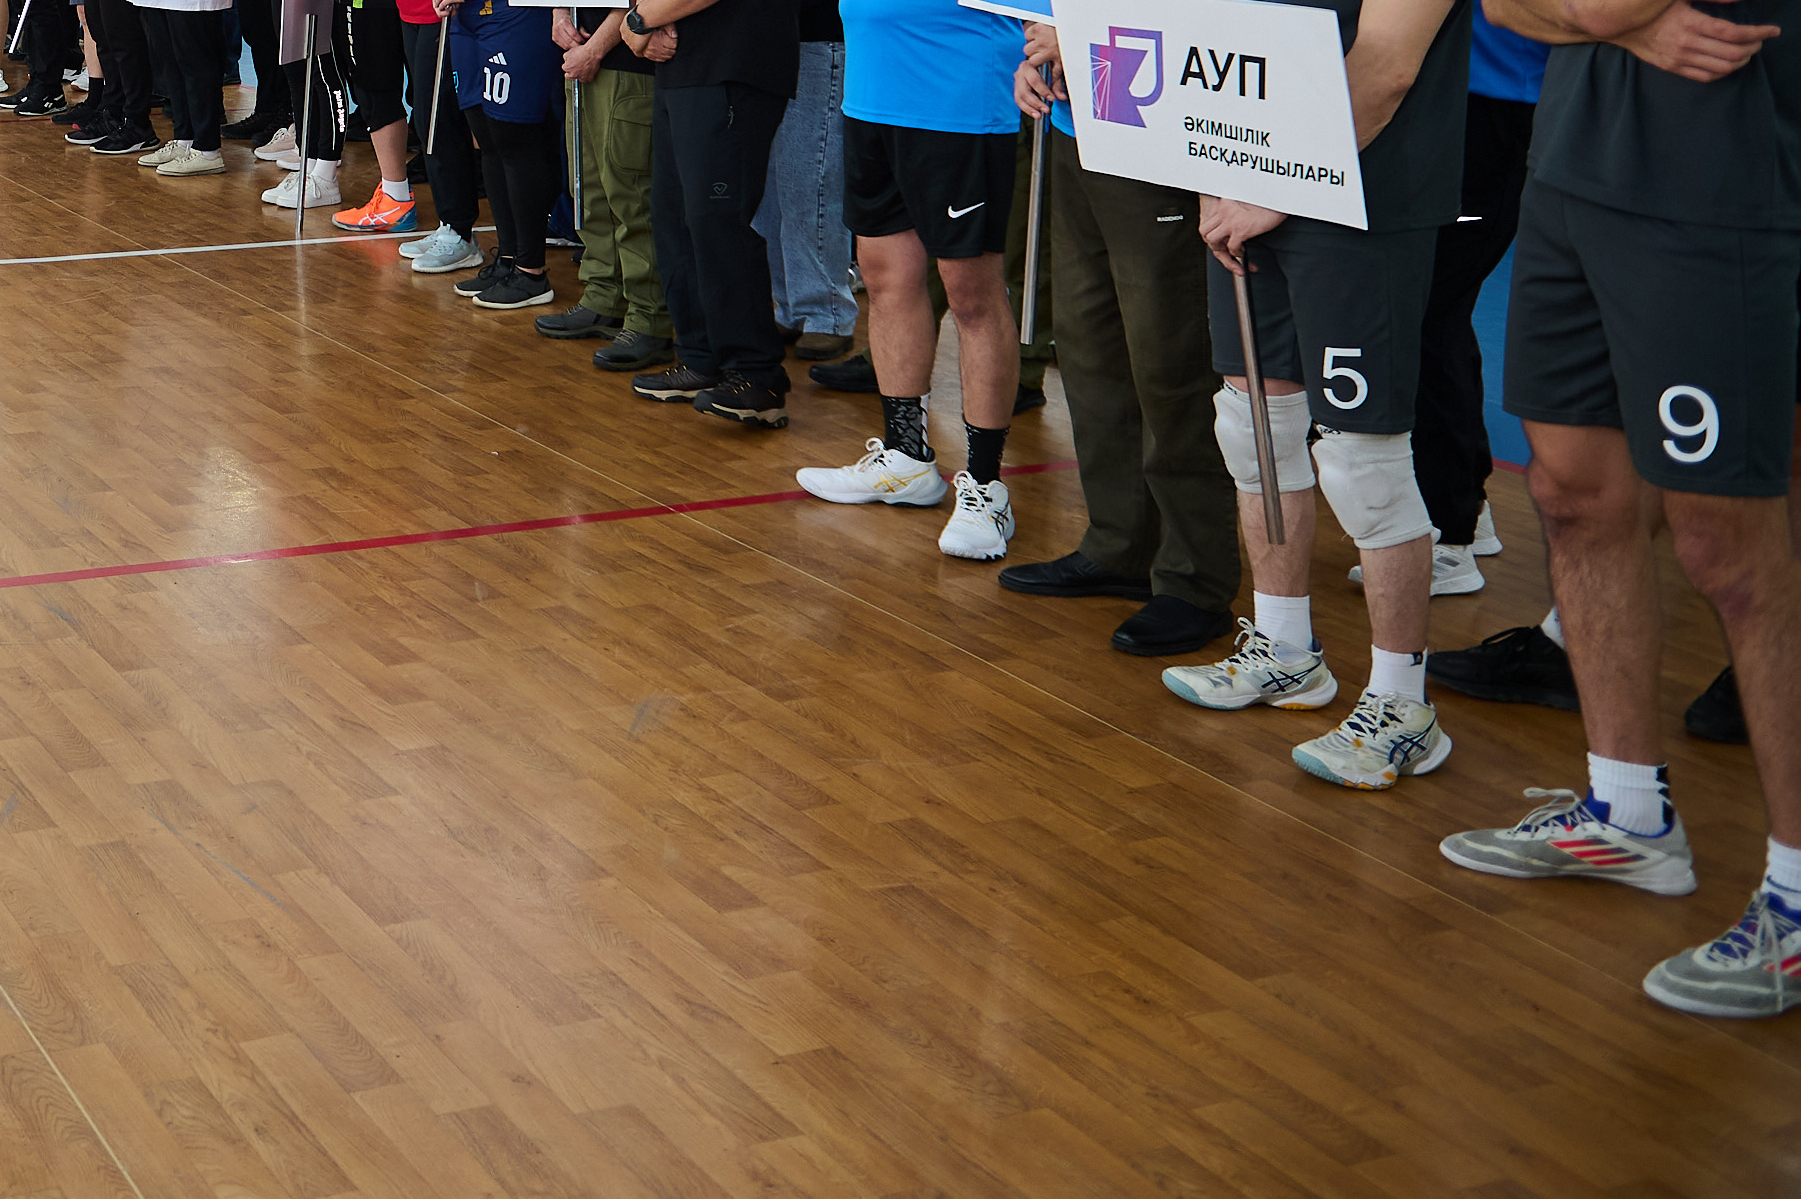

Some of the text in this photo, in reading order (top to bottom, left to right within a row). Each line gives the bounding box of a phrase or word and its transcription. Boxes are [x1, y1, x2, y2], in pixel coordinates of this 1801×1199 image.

[482, 66, 511, 105] 10
[1179, 45, 1267, 100] АУП
[1183, 115, 1271, 148] ӘКІМШІЛІК
[1188, 141, 1345, 187] БАСҚАРУШЫЛАРЫ
[1322, 346, 1368, 410] 5
[1658, 385, 1720, 464] 9
